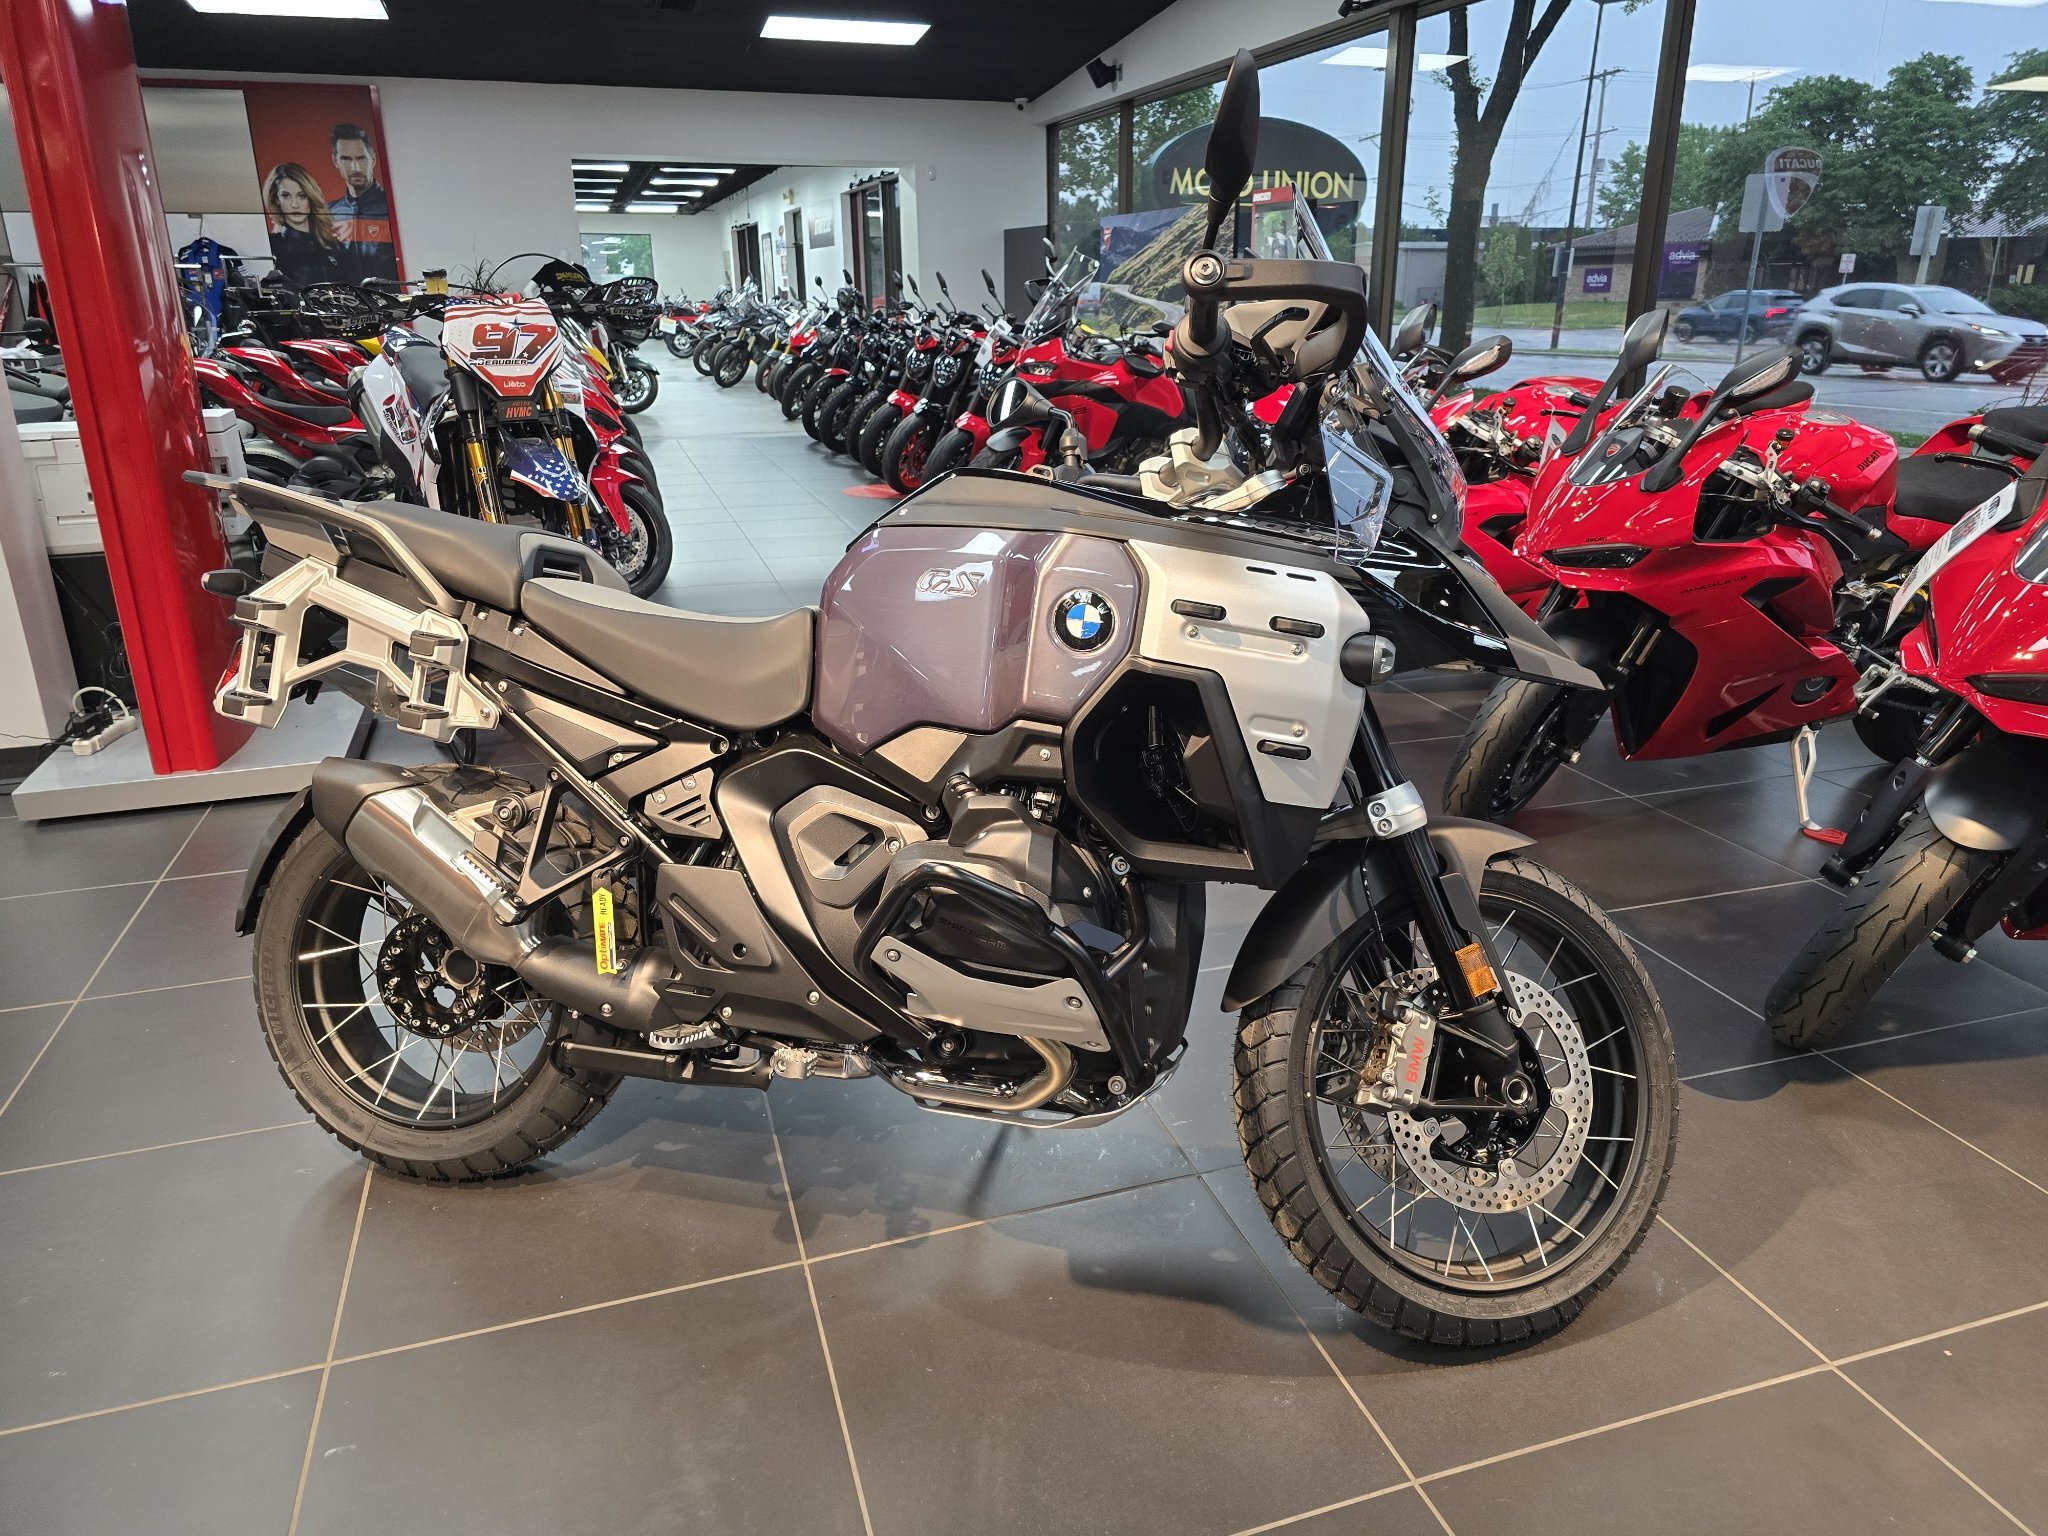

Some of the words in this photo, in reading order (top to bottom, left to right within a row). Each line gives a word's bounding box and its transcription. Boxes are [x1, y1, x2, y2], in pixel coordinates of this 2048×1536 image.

[1668, 250, 1696, 260] advia
[1586, 273, 1608, 283] advia
[469, 323, 558, 360] 97
[506, 406, 532, 418] HVMC
[1856, 449, 1881, 472] DUCATI
[1062, 590, 1110, 615] BMW
[1406, 1034, 1425, 1083] BMW
